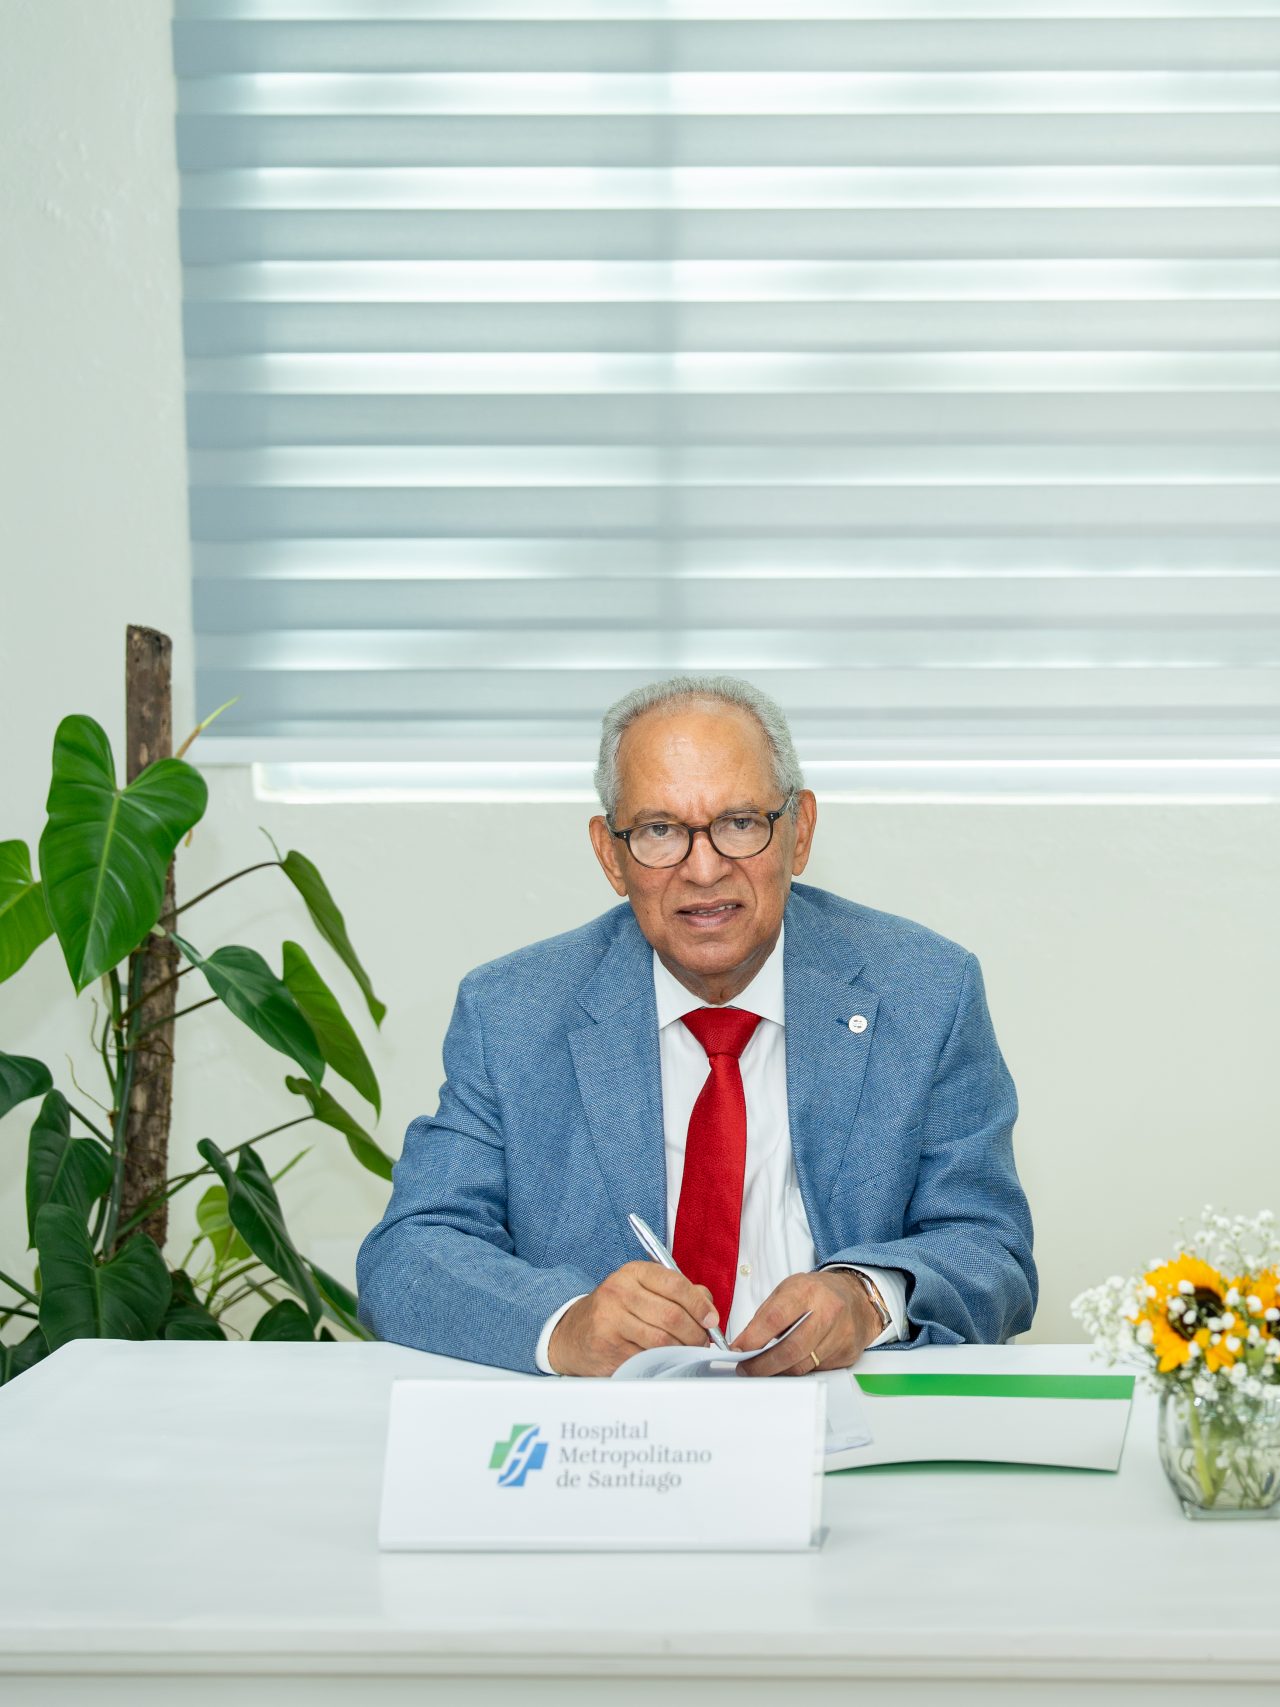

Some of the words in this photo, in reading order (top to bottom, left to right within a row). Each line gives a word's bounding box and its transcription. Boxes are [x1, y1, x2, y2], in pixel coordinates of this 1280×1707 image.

[560, 1420, 649, 1445] Hospital
[558, 1444, 713, 1469] Metropolitano
[556, 1469, 581, 1488] de
[587, 1468, 682, 1494] Santiago
